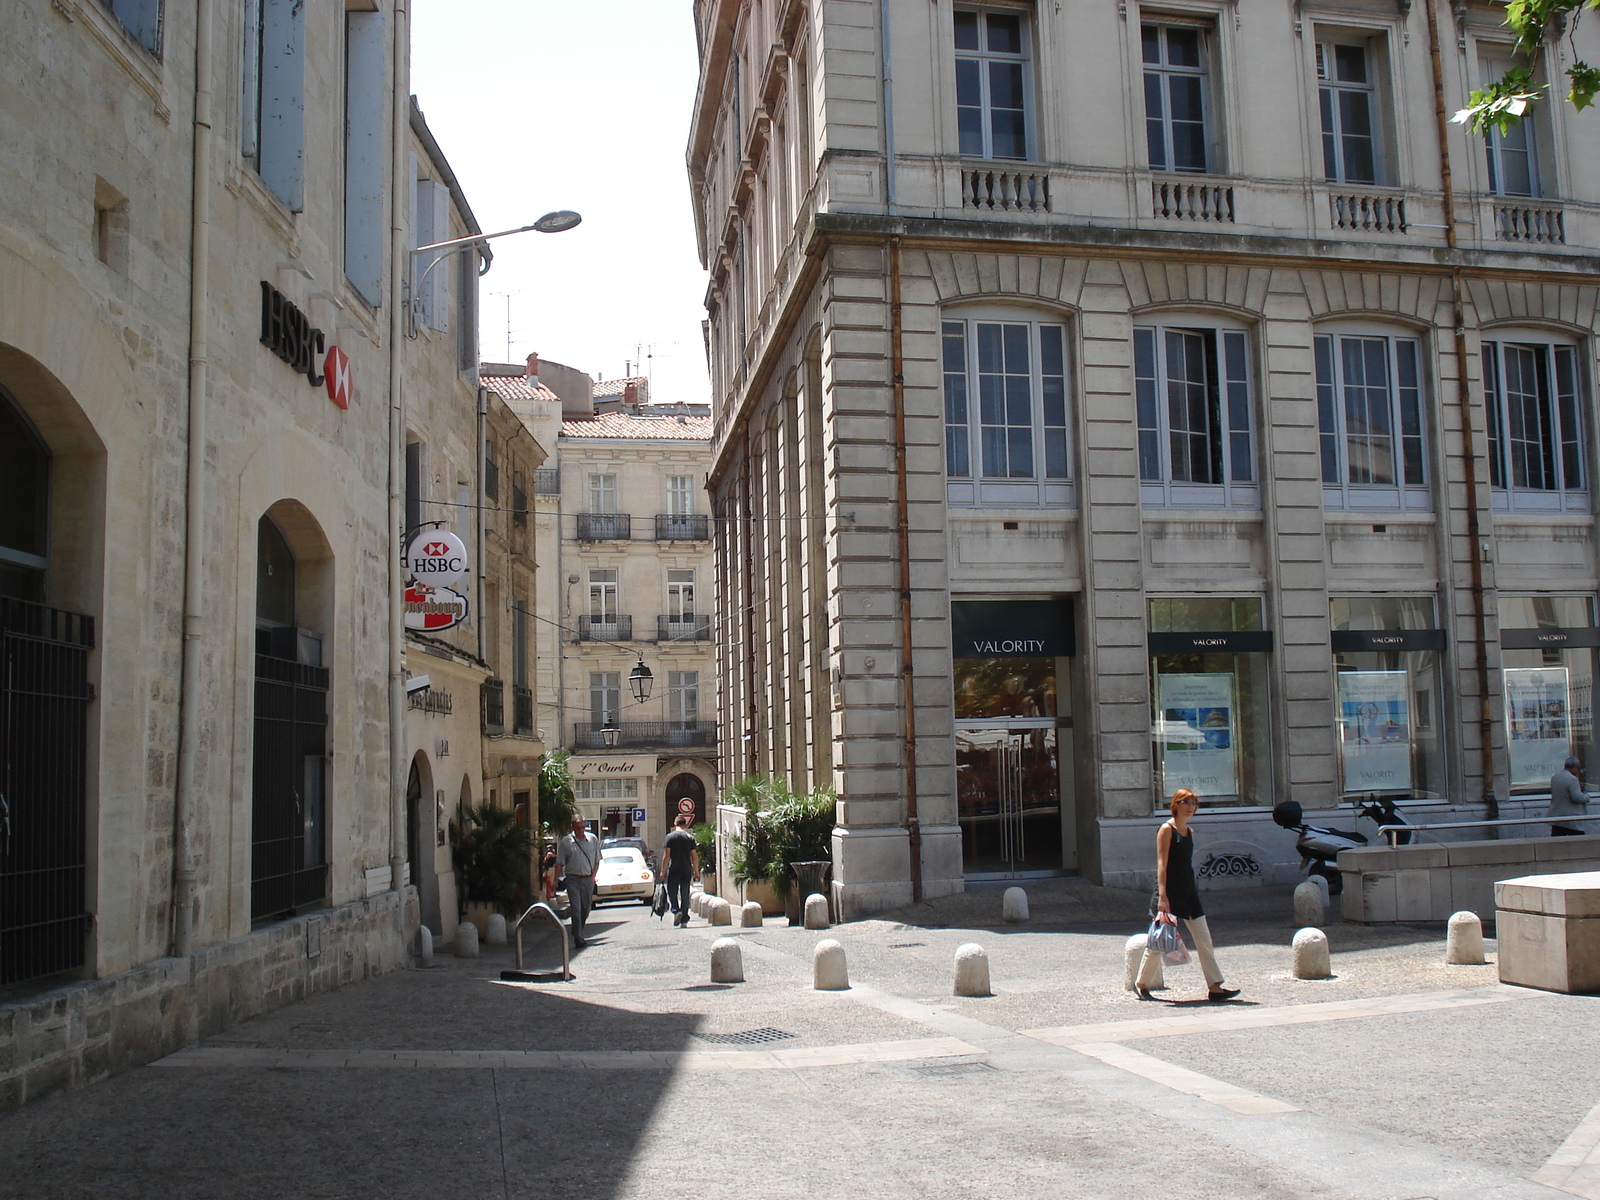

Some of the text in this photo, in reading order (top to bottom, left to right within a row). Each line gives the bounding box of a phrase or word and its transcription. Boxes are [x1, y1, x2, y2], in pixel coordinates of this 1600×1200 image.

[259, 280, 325, 387] HSBC
[413, 558, 461, 573] HSBC
[973, 640, 1045, 653] VALORITY
[1192, 638, 1228, 646] VALORITY
[598, 762, 635, 772] Ourlet
[1359, 770, 1395, 779] VALORITY
[635, 810, 643, 820] P
